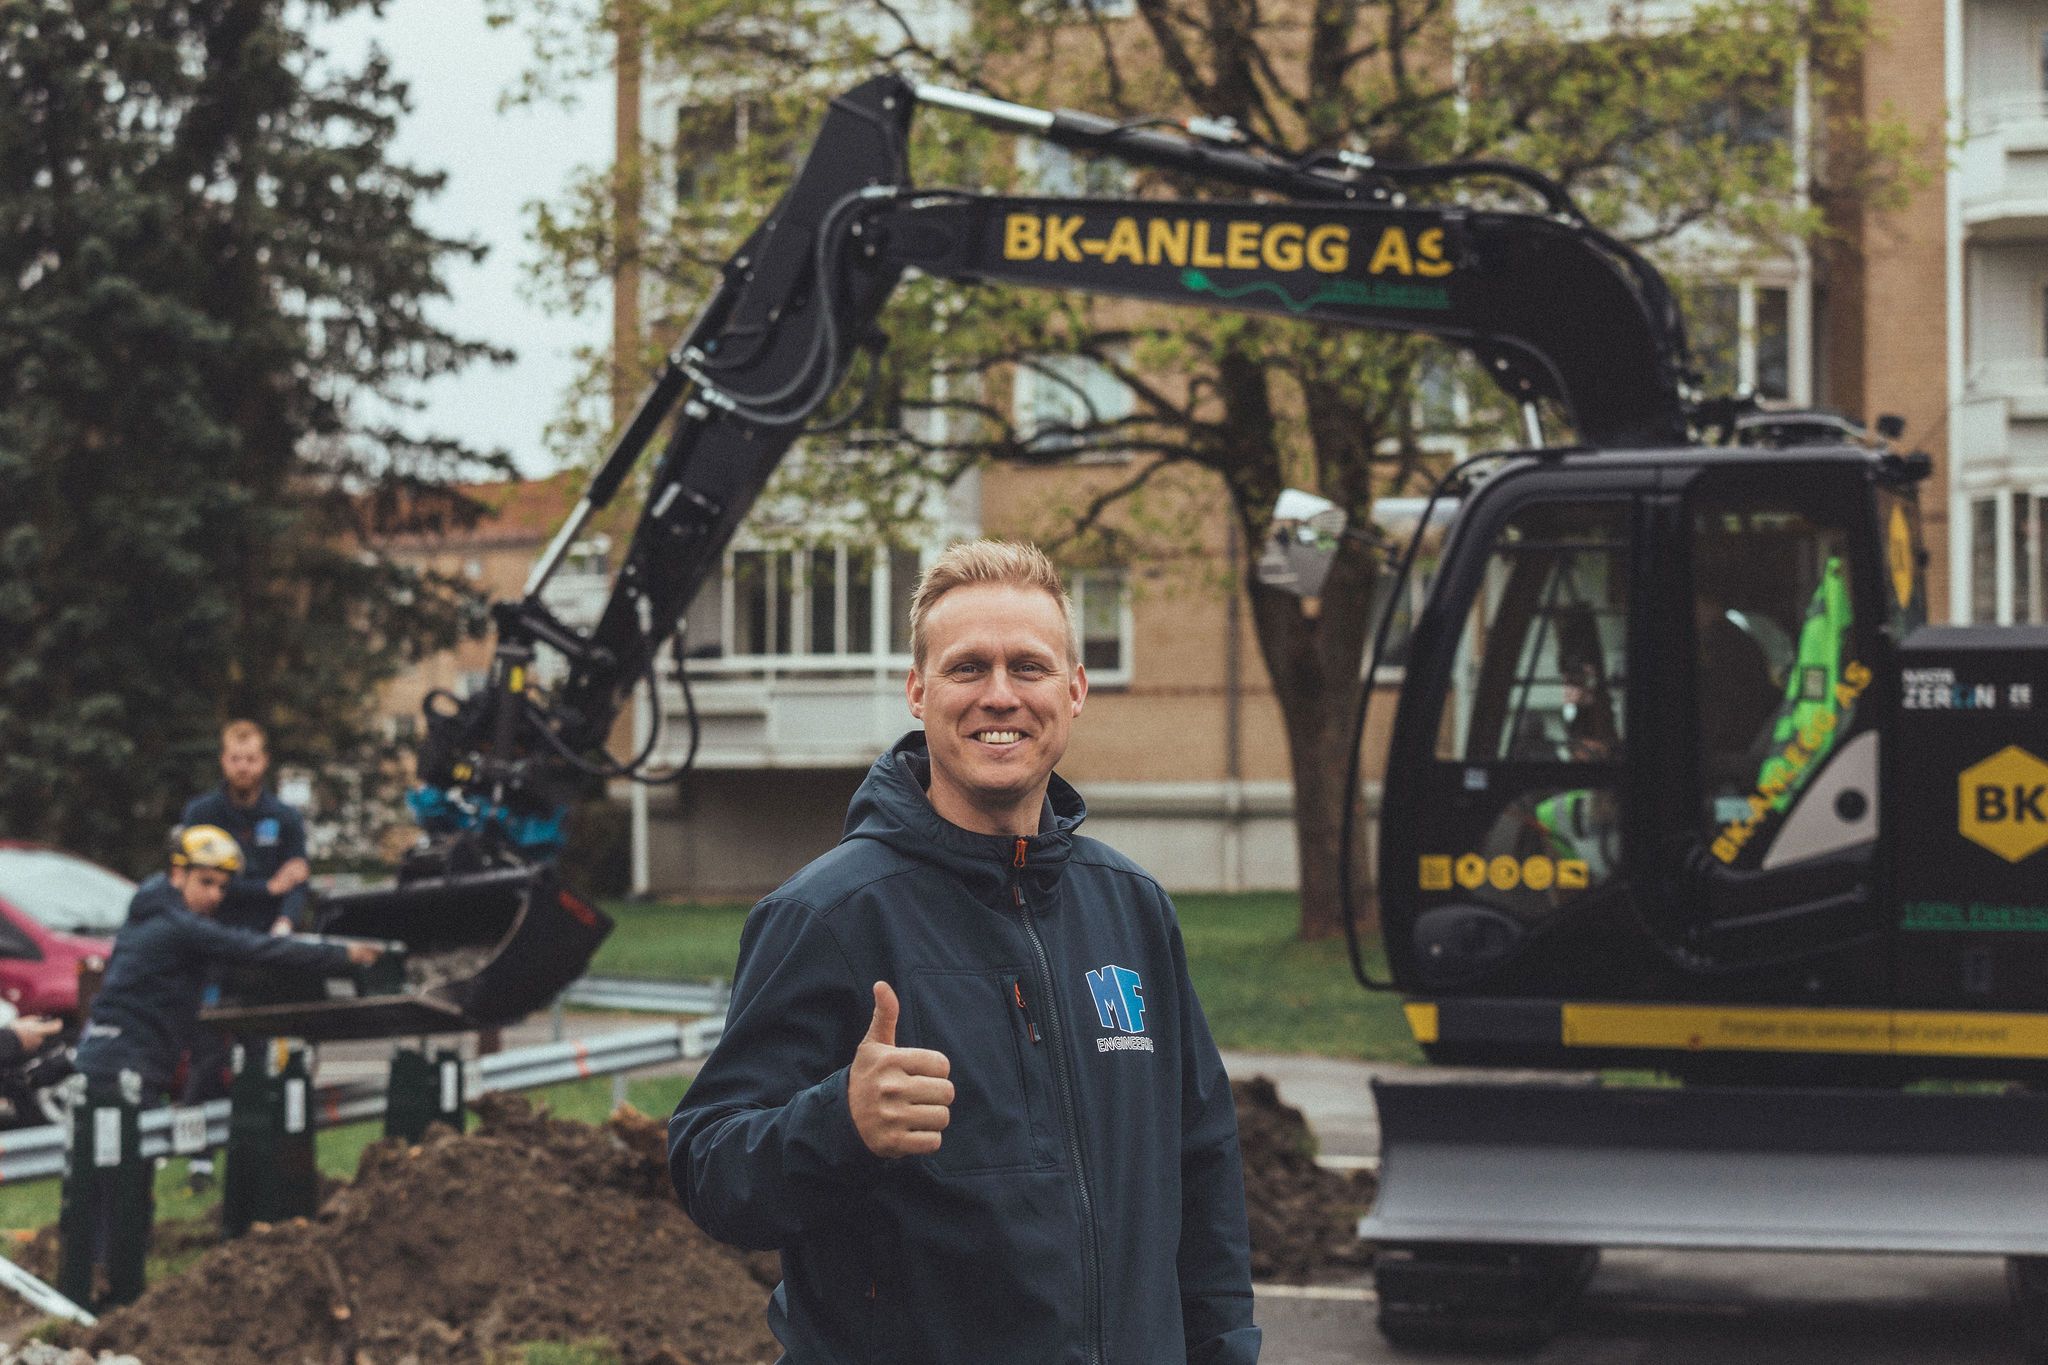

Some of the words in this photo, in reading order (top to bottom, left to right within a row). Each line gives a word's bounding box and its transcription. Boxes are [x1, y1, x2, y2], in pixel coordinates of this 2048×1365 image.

[1003, 213, 1350, 274] BK-ANLEGG
[1368, 227, 1454, 277] AS
[1836, 660, 1873, 709] AS
[1976, 783, 2048, 823] BK
[1085, 965, 1146, 1034] MF
